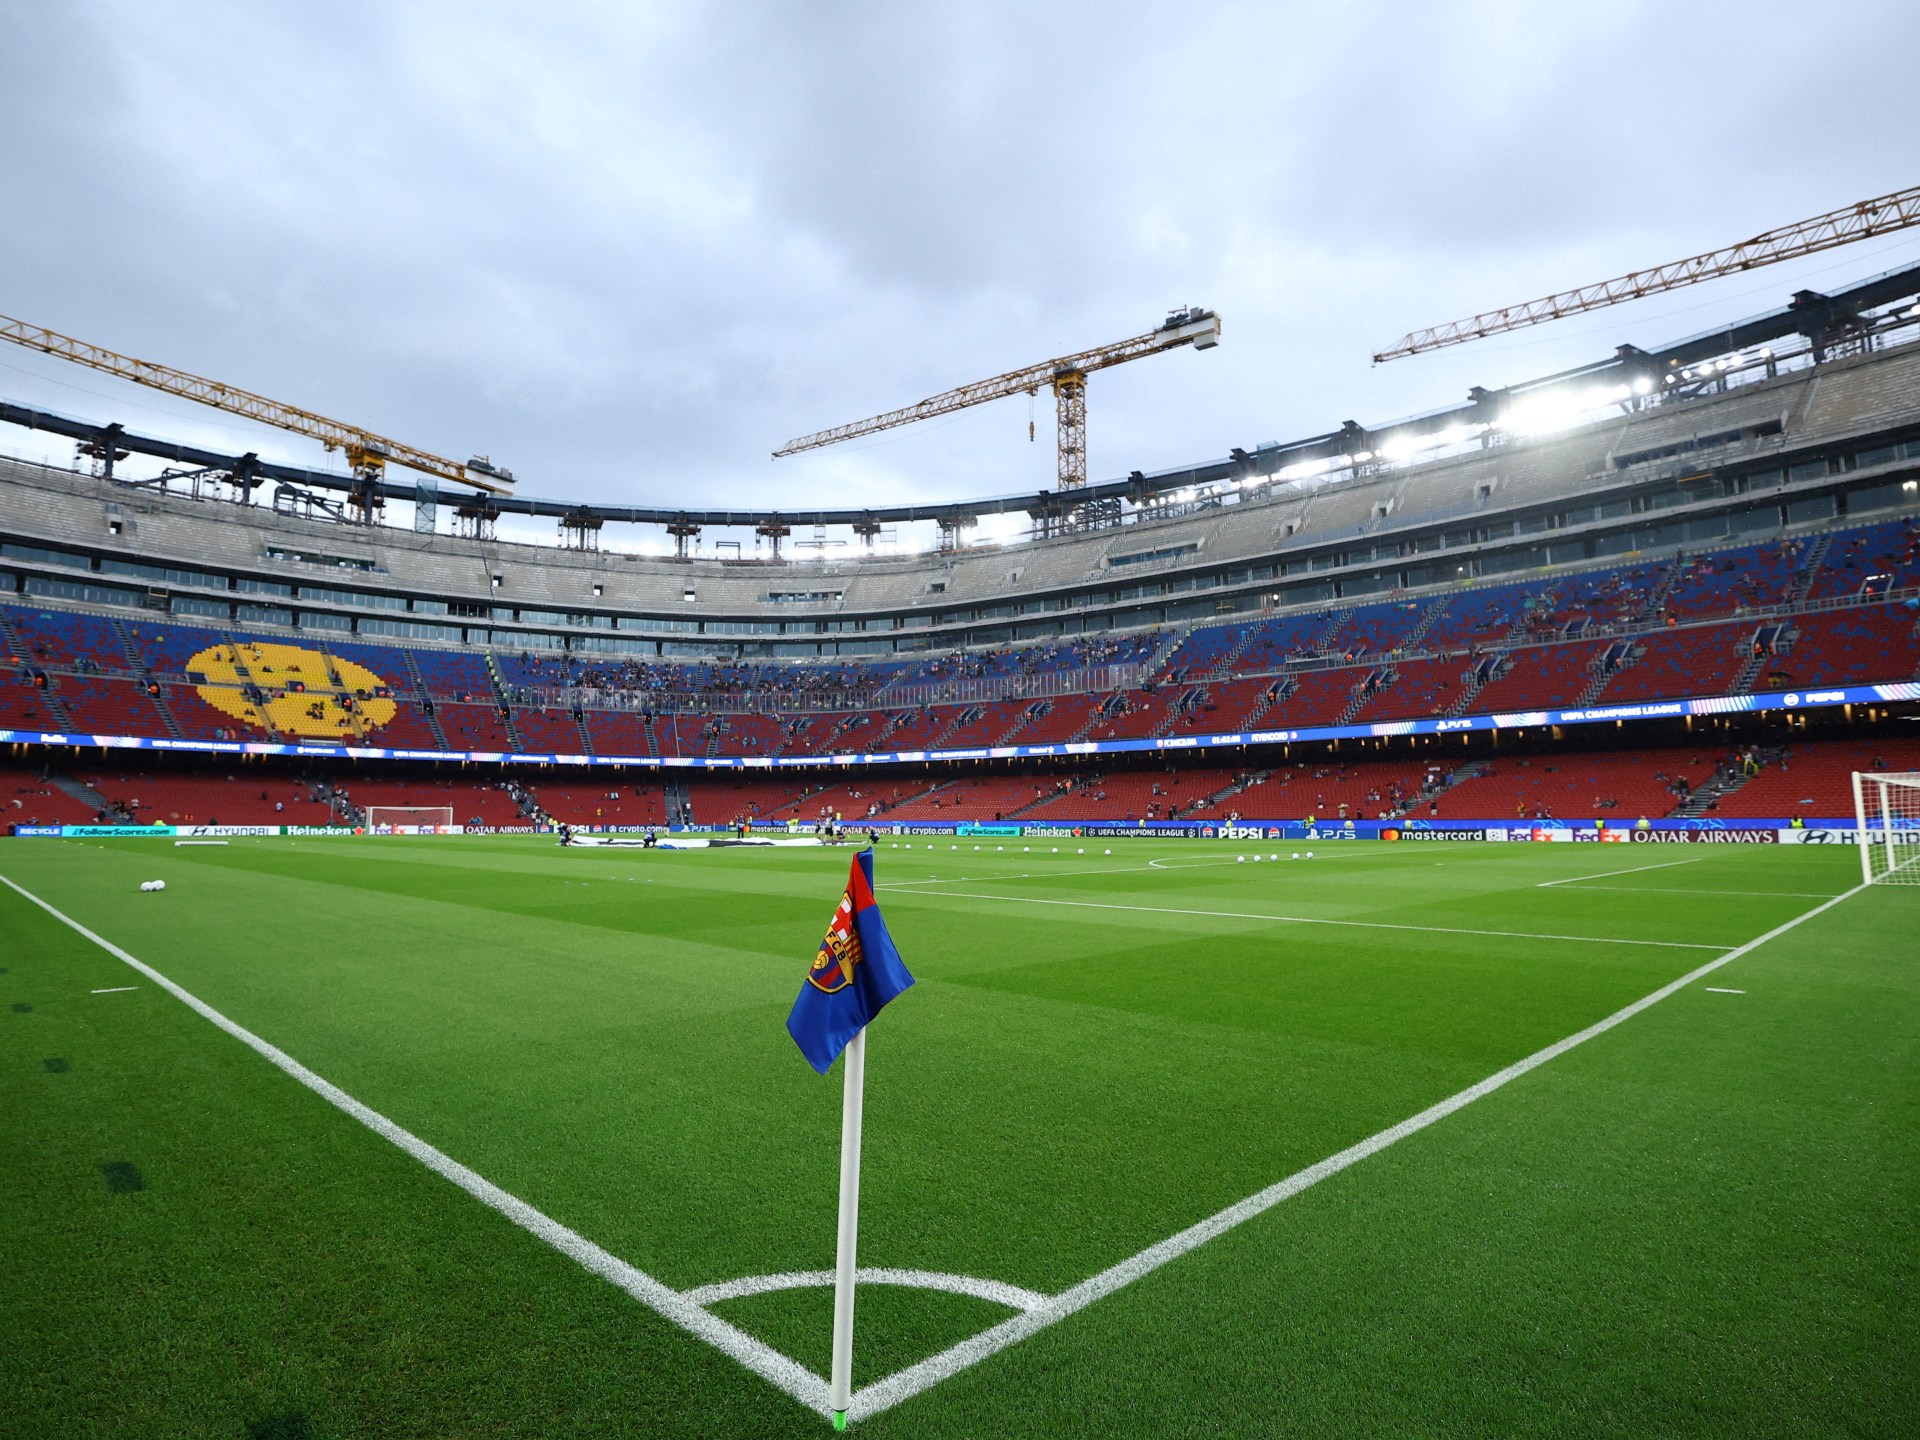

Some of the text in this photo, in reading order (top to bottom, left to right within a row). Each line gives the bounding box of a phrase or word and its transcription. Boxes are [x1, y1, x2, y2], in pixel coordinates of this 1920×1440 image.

[1561, 704, 1681, 720] UEFA CHAMPIONS LEAGUE
[214, 828, 269, 836] HYUNDAI
[287, 826, 352, 836] Heineken
[911, 827, 954, 836] crypto.com
[1023, 827, 1072, 837] Heineken
[1117, 829, 1156, 837] CHAMPIONS
[1218, 828, 1264, 838] PEPSI
[1323, 830, 1356, 840] PS5
[1402, 830, 1483, 841] mastercard
[1508, 829, 1553, 842] FedEx
[1573, 829, 1622, 842] FedEx
[1634, 831, 1773, 843] QATAR AIRWAYS
[825, 930, 847, 961] FCB
